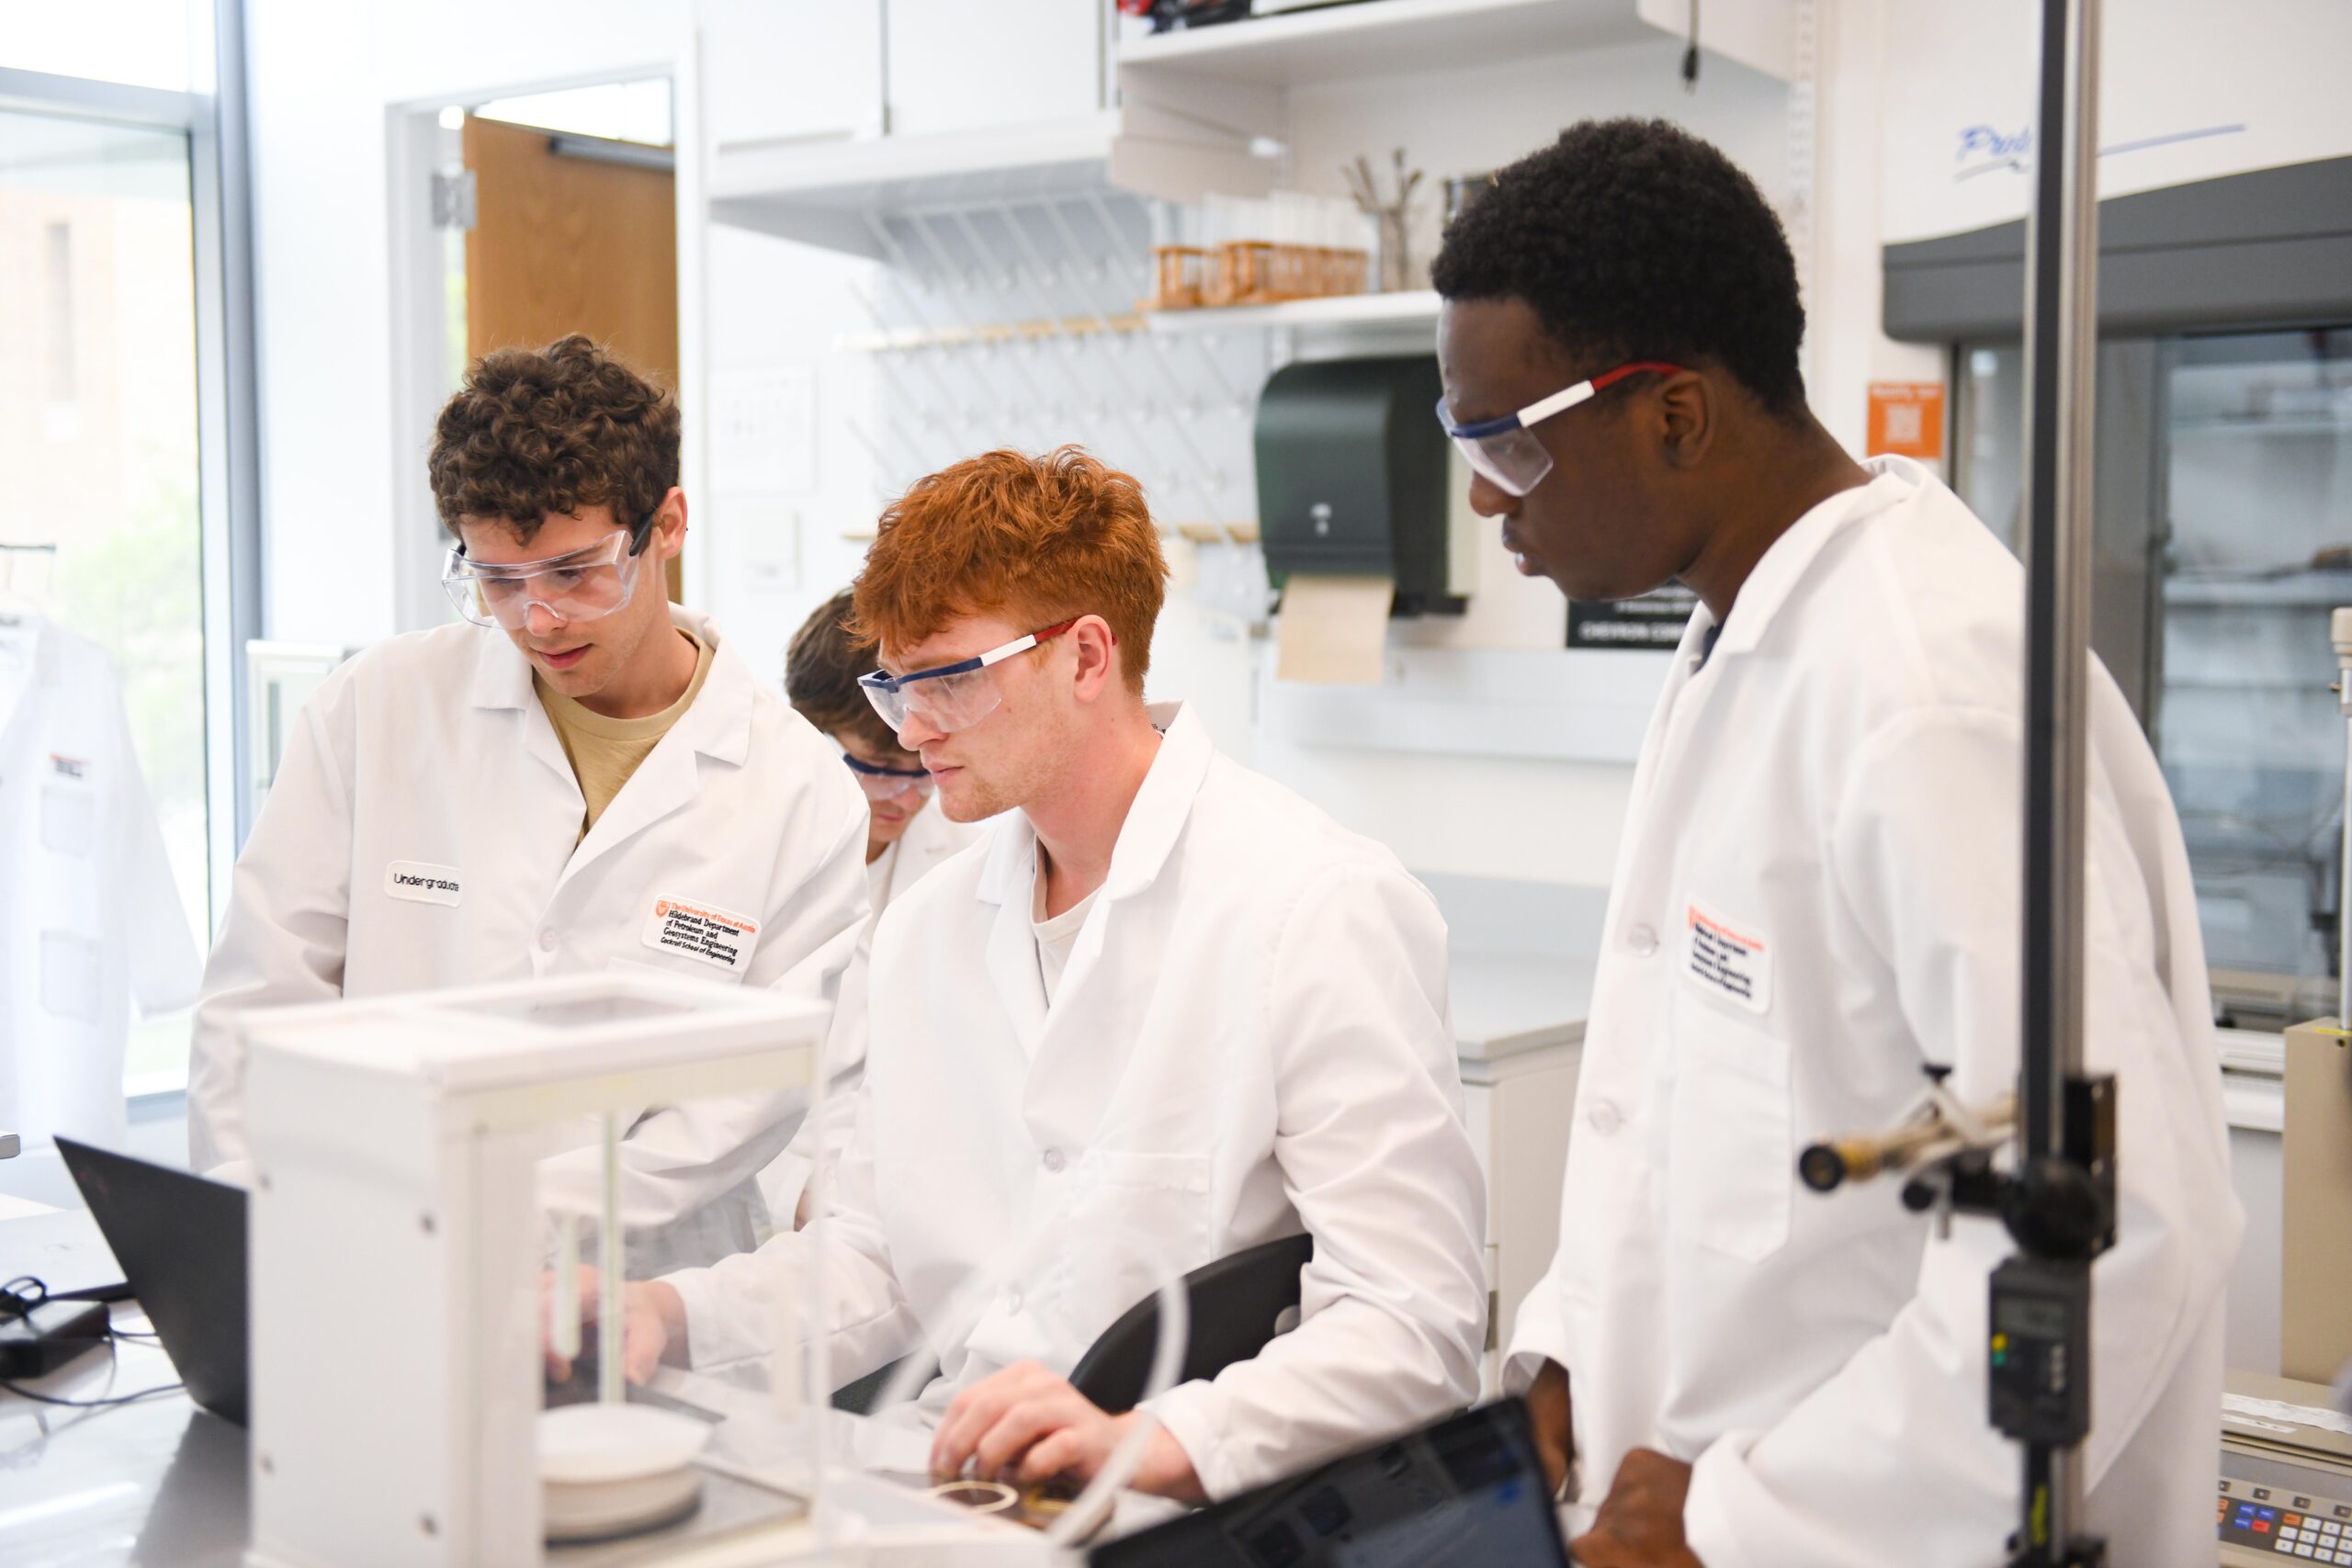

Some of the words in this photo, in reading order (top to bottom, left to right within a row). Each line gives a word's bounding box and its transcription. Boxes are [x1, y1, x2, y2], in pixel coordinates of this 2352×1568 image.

[669, 909, 703, 925] Hildebrand
[704, 919, 740, 936] Department
[674, 919, 704, 935] Petroleum
[706, 931, 718, 940] and
[663, 927, 699, 942] Geosystems
[700, 936, 738, 957] Engineering
[682, 942, 699, 952] School
[706, 949, 736, 965] Engineering
